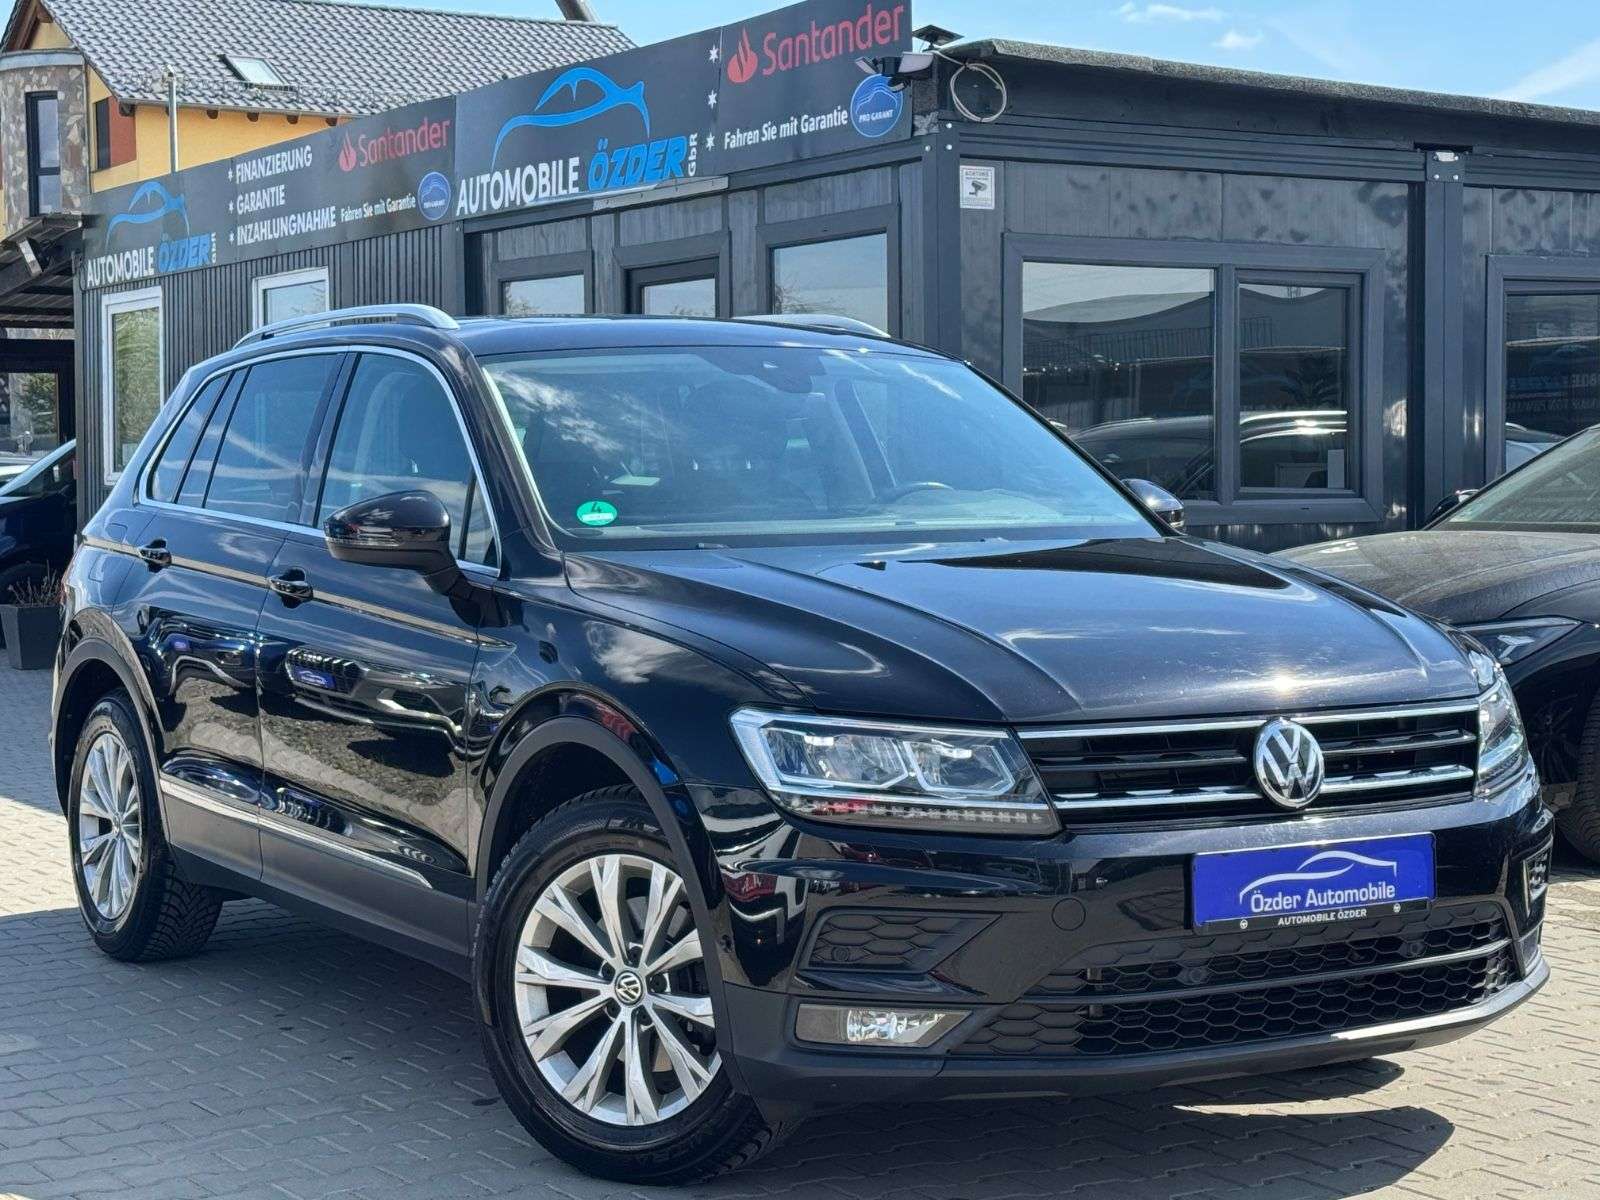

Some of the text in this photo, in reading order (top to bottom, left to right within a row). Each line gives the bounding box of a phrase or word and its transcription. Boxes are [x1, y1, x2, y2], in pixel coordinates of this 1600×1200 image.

[762, 3, 905, 76] Santander
[358, 116, 451, 167] Santander
[724, 105, 849, 150] Fahren Sie mit Garantie
[235, 145, 313, 185] FINANZIERUNG
[456, 135, 688, 217] AUTOMOBILE ÖZDER
[688, 132, 698, 177] GbR
[236, 184, 286, 215] GARANTIE
[340, 206, 363, 222] Fahren
[363, 202, 374, 218] Sie
[374, 198, 386, 215] mit
[386, 193, 416, 213] Garantie
[236, 205, 337, 246] INZAHLUNGNAHME
[86, 232, 212, 288] AUTOMOBILE ÖZDER
[1250, 880, 1396, 914] Özder Automobile
[1277, 907, 1368, 927] AUTOMOBILE ÖZDER
